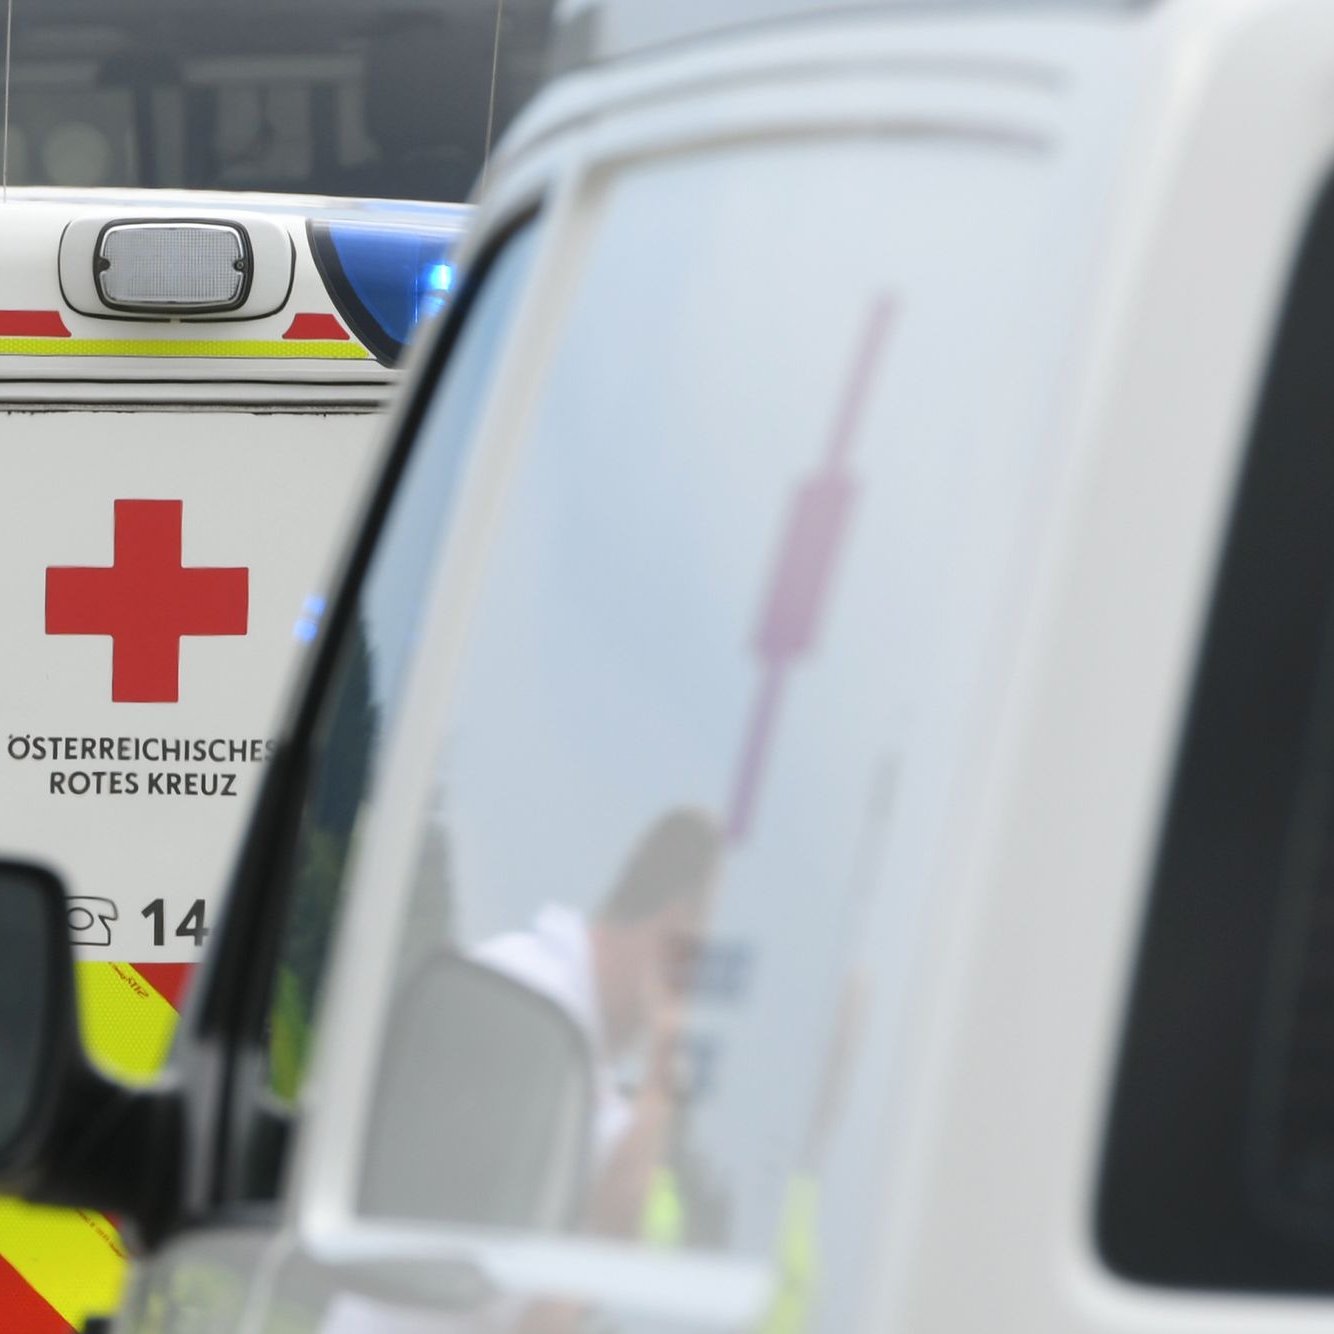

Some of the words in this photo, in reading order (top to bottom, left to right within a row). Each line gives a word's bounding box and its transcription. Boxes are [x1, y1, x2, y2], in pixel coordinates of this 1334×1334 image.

[7, 734, 277, 763] ÖSTERREICHISCHES
[49, 771, 139, 795] ROTES
[147, 772, 237, 797] KREUZ
